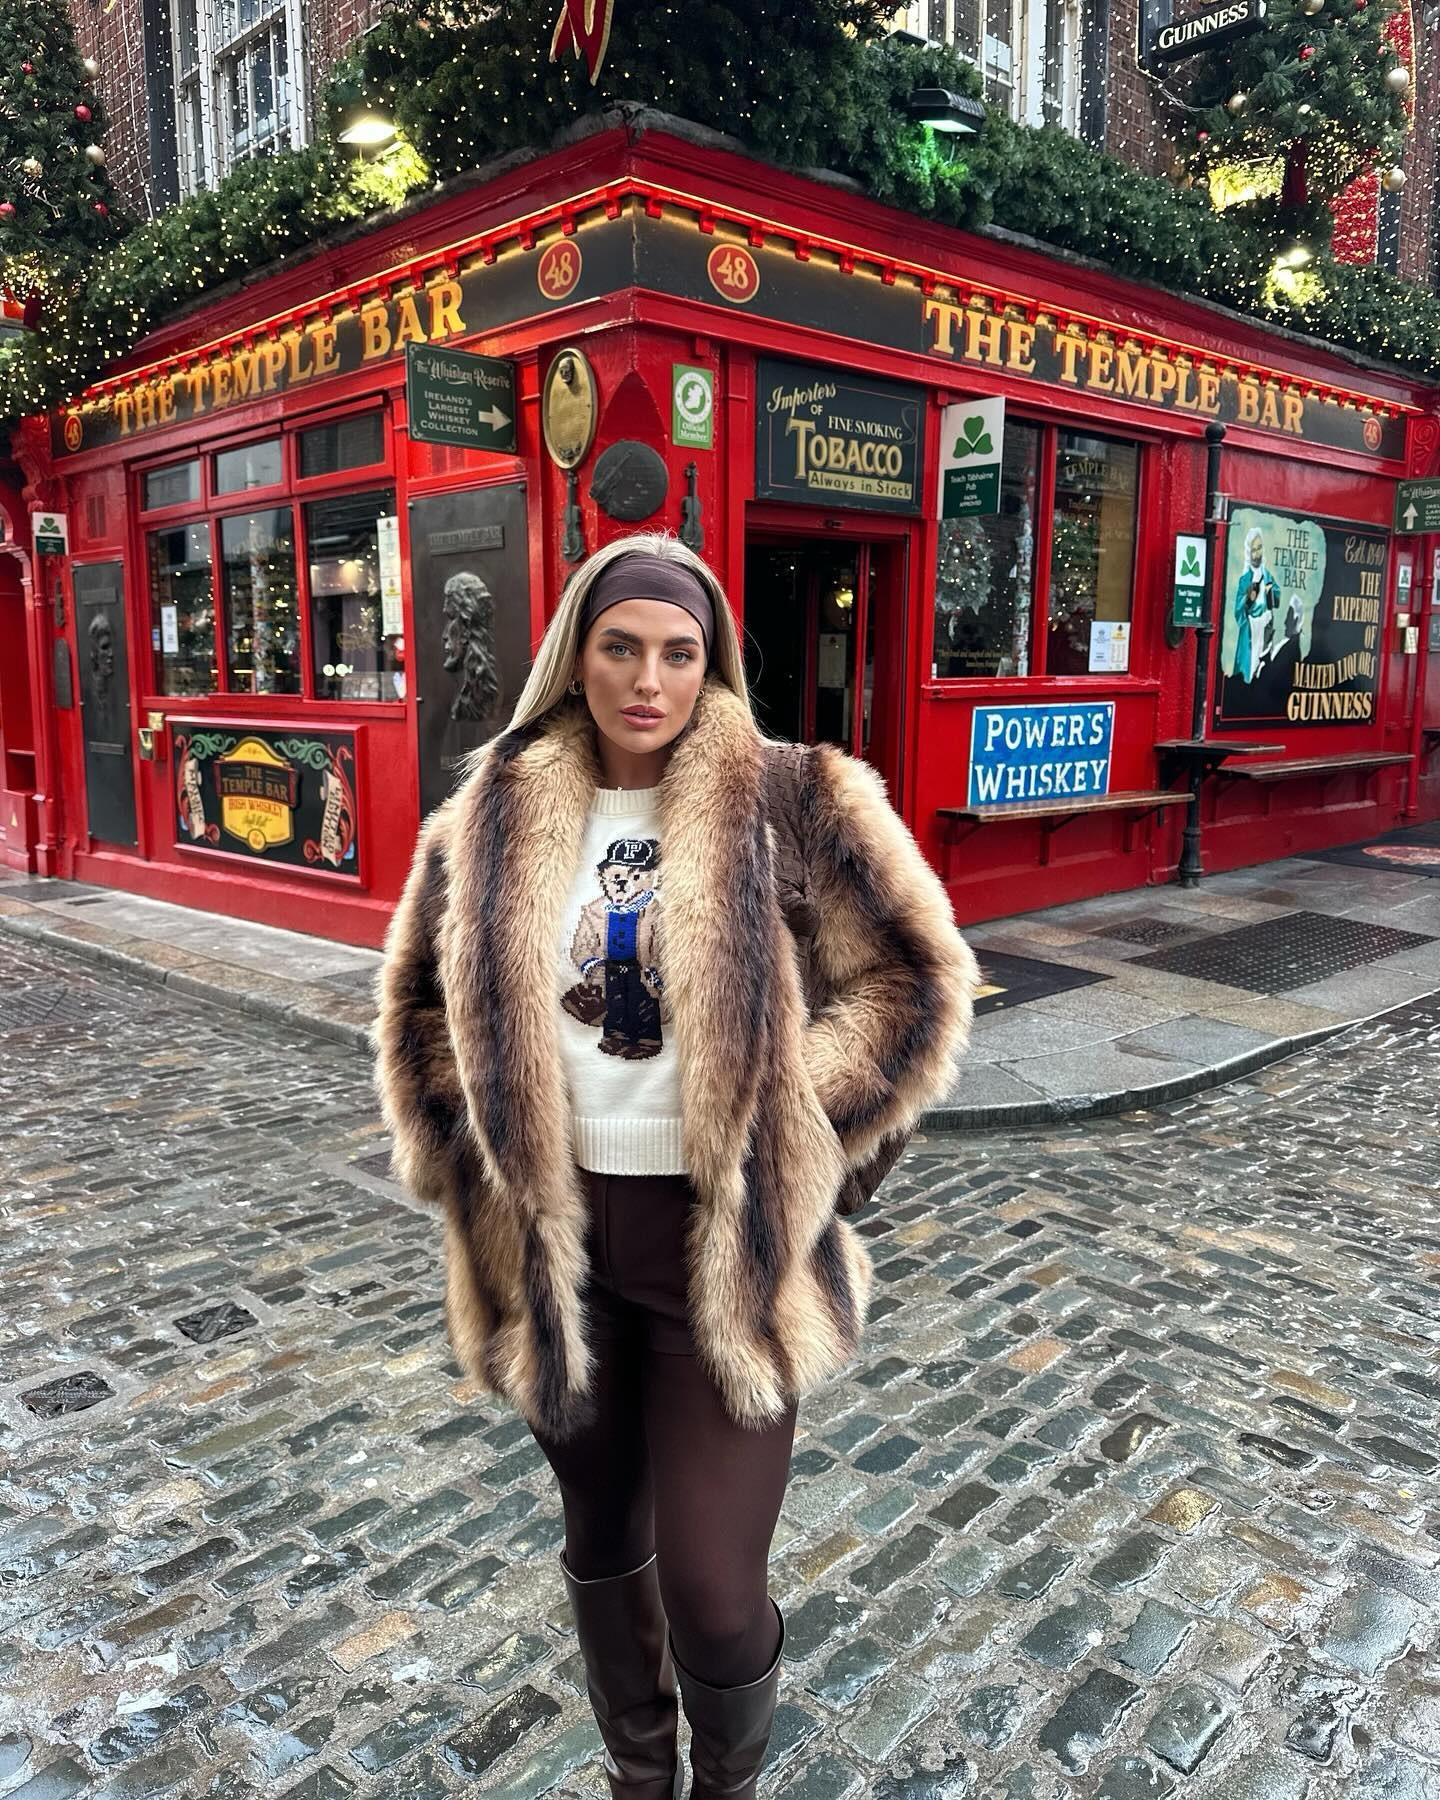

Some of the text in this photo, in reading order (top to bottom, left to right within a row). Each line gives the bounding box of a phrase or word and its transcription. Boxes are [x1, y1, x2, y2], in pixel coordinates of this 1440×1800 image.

[1159, 1, 1249, 49] GUINNESS
[545, 251, 573, 290] 48
[716, 252, 748, 290] 48
[114, 281, 467, 435] THE TEMPLE BAR
[924, 299, 1304, 434] THE TEMPLE BAR
[427, 357, 473, 385] Whiskey
[473, 368, 511, 391] Reserve
[424, 390, 473, 406] IRELAND'S
[428, 401, 471, 415] LARGEST
[766, 382, 837, 417] Importers
[811, 404, 824, 415] OF
[420, 420, 478, 436] COLLECTION
[428, 411, 471, 425] WHISKEY
[828, 415, 903, 440] FINE SMOKING
[680, 429, 707, 442] Member
[785, 417, 903, 479] TOBACCO
[810, 471, 911, 497] Always in Stock
[1286, 528, 1310, 550] THE
[1273, 546, 1319, 571] TEMPLE
[1283, 567, 1307, 590] BAR
[1360, 571, 1381, 597] THE
[1332, 595, 1380, 624] EMPEROR
[1364, 624, 1378, 650] OF
[1292, 650, 1377, 690] MALTED LIQUORS
[1287, 691, 1373, 721] GUINNESS
[245, 765, 264, 780] THE
[974, 758, 1108, 802] WHISKEY
[222, 777, 289, 802] TEMPLE BAR
[247, 798, 283, 818] WHISKEY
[624, 841, 643, 860] P
